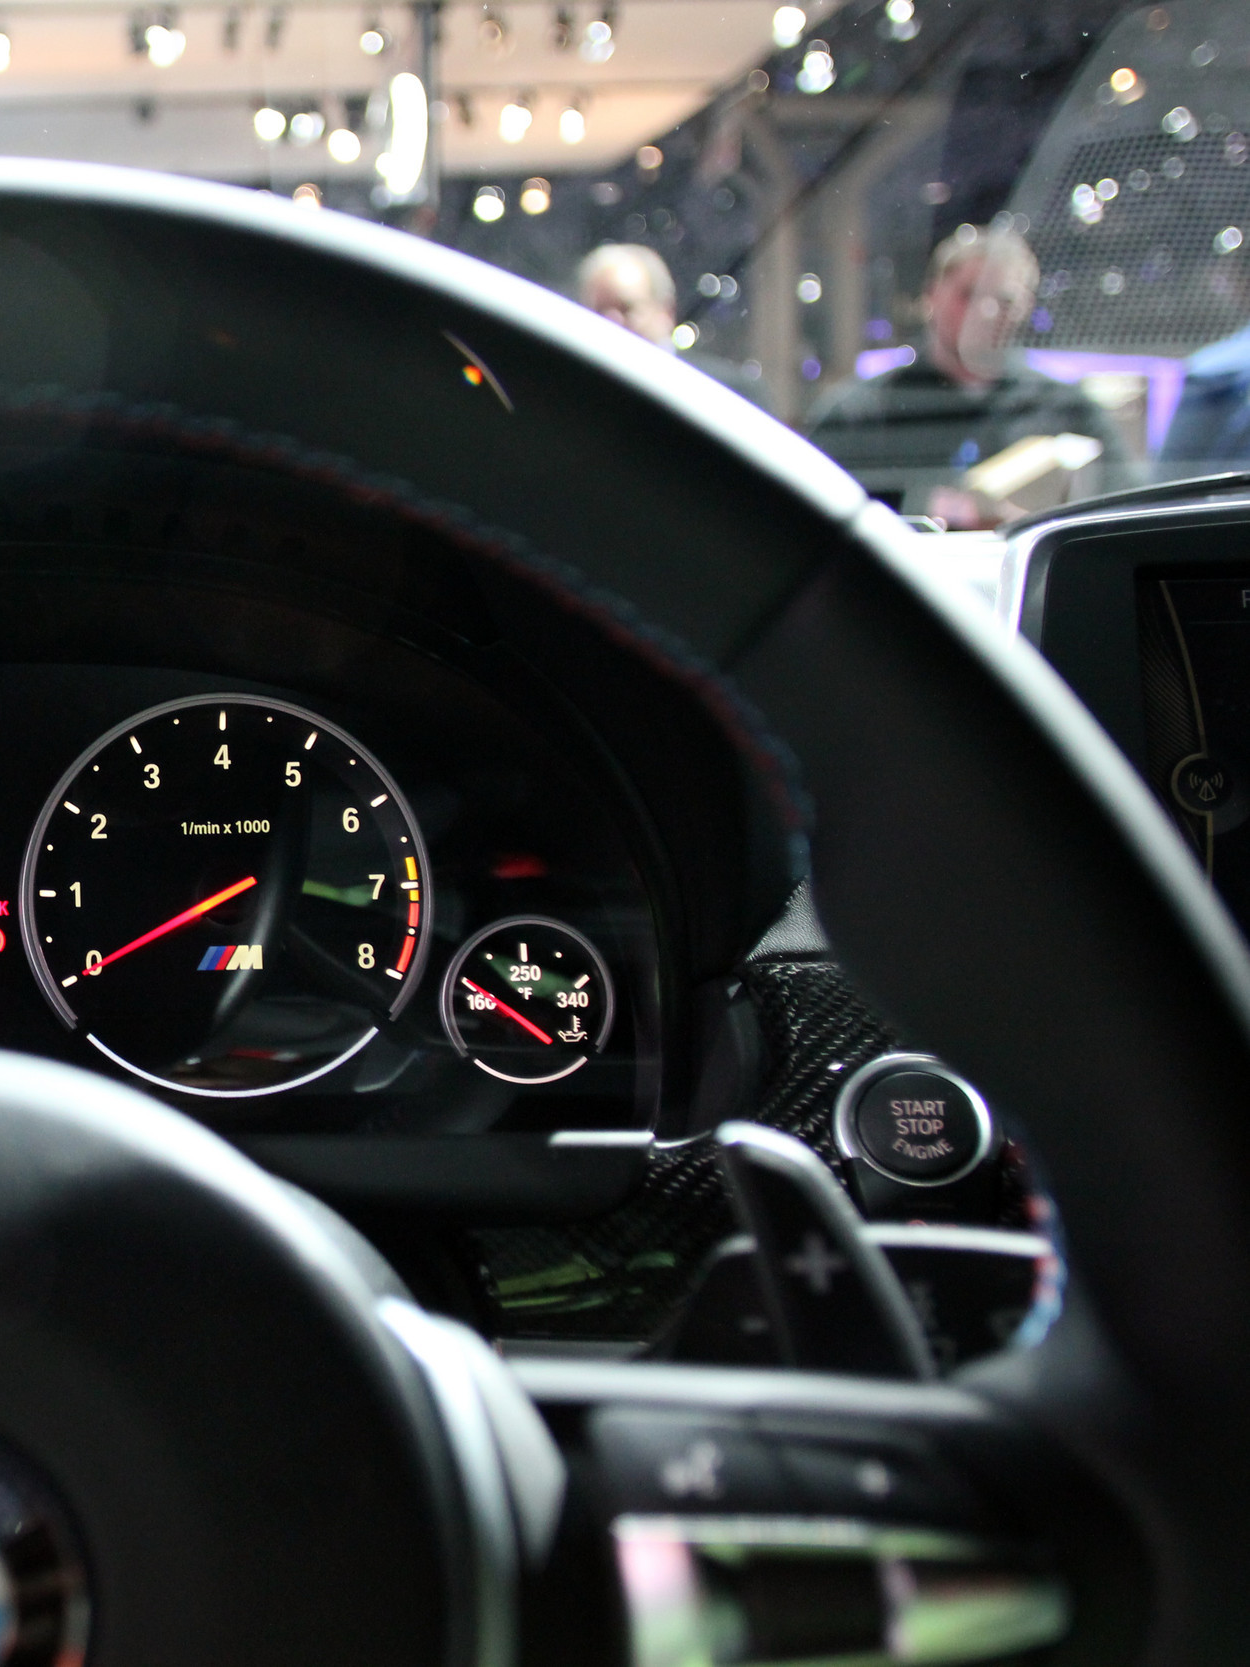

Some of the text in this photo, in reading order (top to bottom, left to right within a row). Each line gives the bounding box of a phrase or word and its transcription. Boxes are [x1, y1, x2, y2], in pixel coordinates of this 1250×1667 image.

[213, 744, 232, 770] 4
[143, 763, 161, 789] 3
[285, 761, 302, 787] 5
[90, 813, 108, 840] 2
[180, 819, 270, 835] 1/min x 1000
[342, 807, 360, 833] 6
[69, 881, 82, 908] 1
[368, 873, 386, 900] 7
[85, 949, 103, 976] 0
[226, 944, 263, 971] M
[358, 943, 375, 970] 8
[509, 965, 542, 982] 250
[556, 991, 589, 1009] 340
[890, 1100, 947, 1117] START
[896, 1118, 945, 1136] STOP
[892, 1137, 954, 1160] ENGINE
